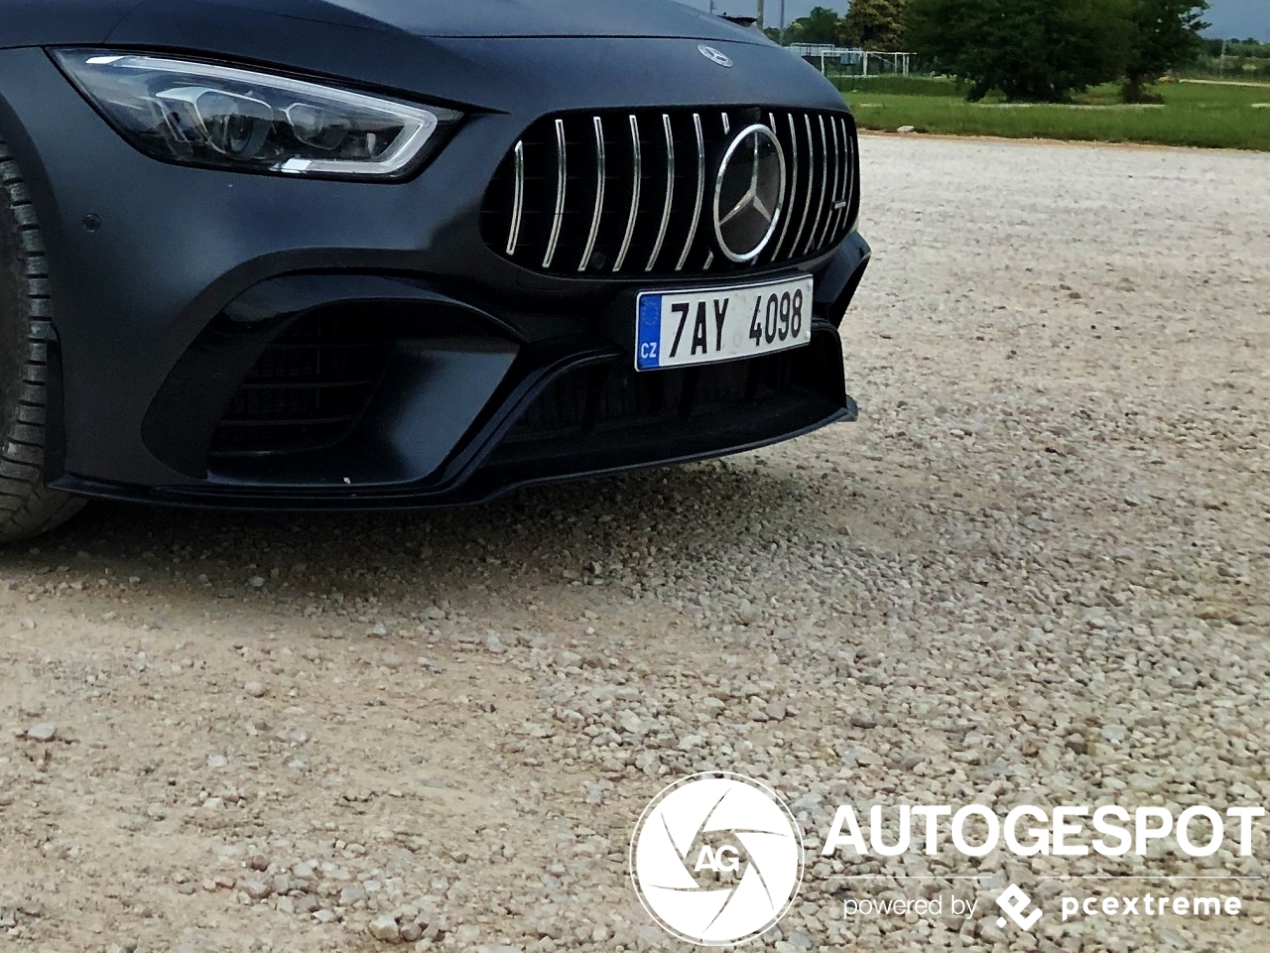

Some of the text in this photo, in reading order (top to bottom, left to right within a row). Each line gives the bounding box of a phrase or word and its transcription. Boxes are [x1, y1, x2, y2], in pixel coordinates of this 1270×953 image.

[668, 288, 803, 358] 7AY 4098
[641, 342, 657, 358] CZ
